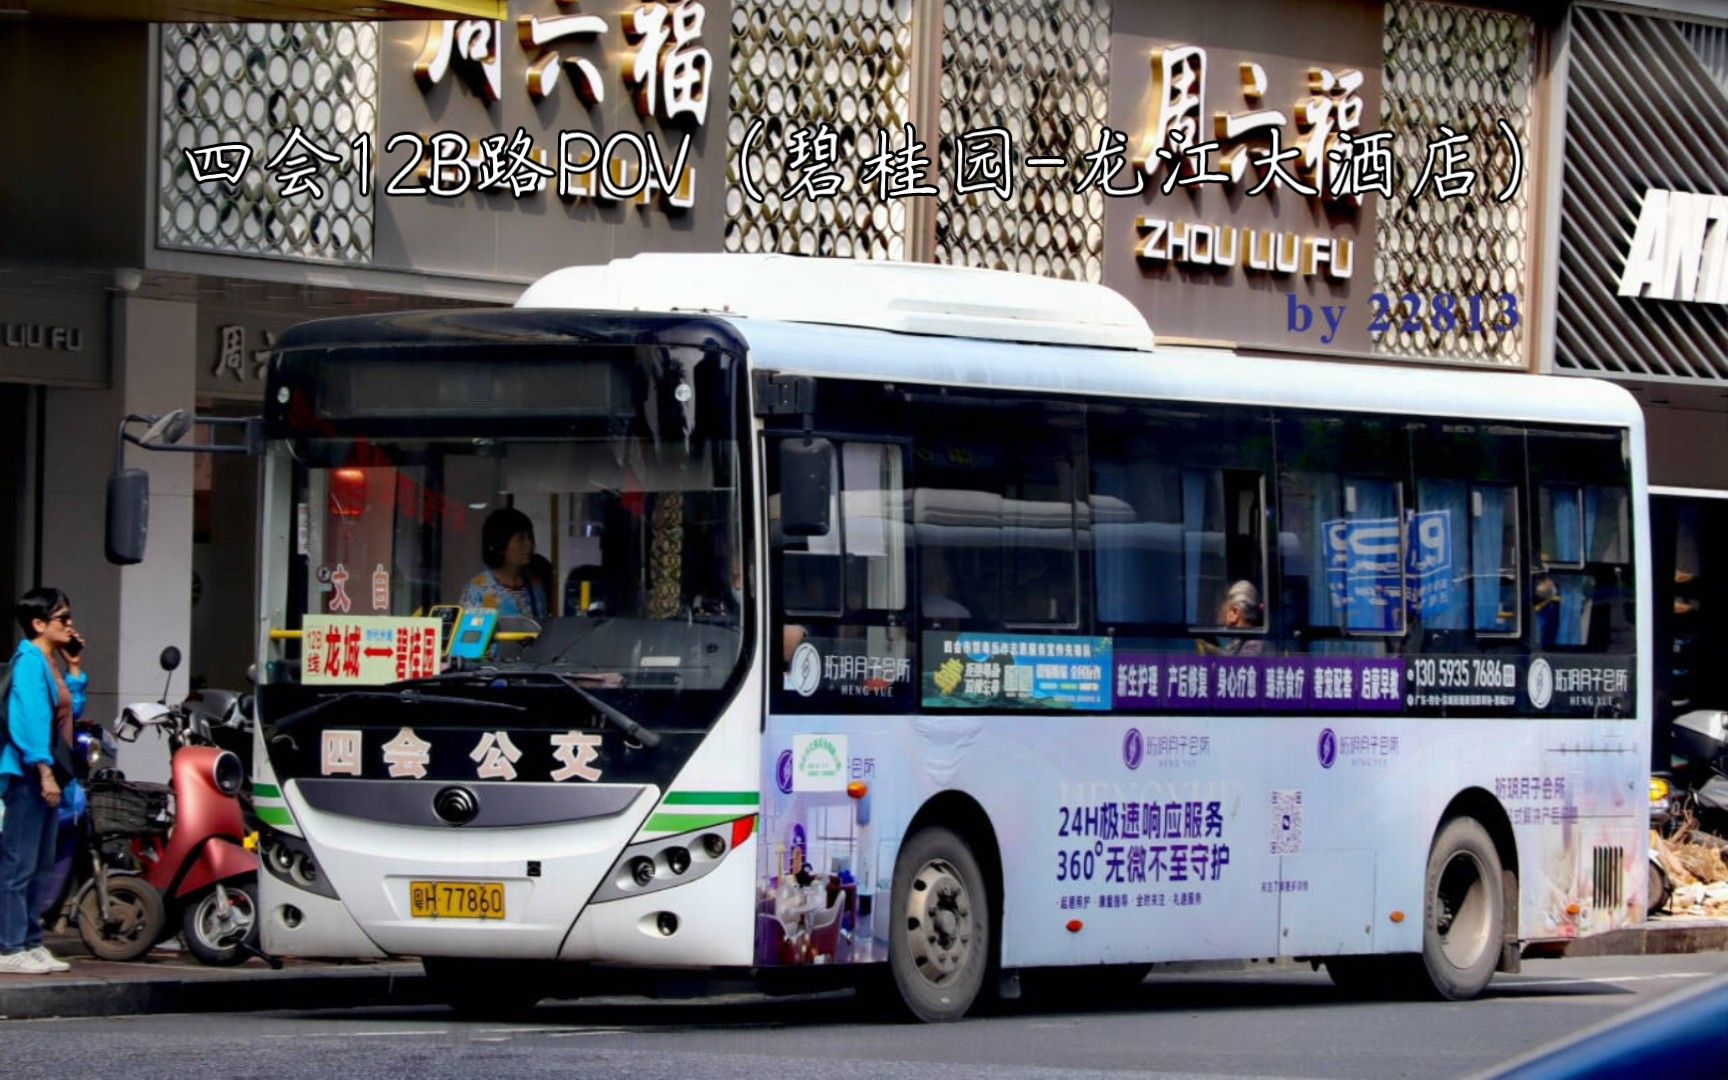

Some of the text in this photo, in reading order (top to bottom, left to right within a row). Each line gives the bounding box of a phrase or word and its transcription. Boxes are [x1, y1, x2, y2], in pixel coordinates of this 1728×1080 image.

[1136, 218, 1355, 279] ZHOU LIU FU
[5, 322, 84, 350] LIU FU
[324, 624, 362, 679] 龙城
[841, 684, 870, 697] HENG
[1117, 664, 1159, 698] 新生护理
[1168, 665, 1208, 698] 产后修复
[1361, 667, 1400, 700] 启蒙早教
[1415, 659, 1436, 687] 130
[1439, 659, 1470, 688] 5935
[1473, 660, 1501, 688] 7686
[320, 727, 602, 781] 四会公交
[1058, 801, 1223, 840] 24H极速响应服务
